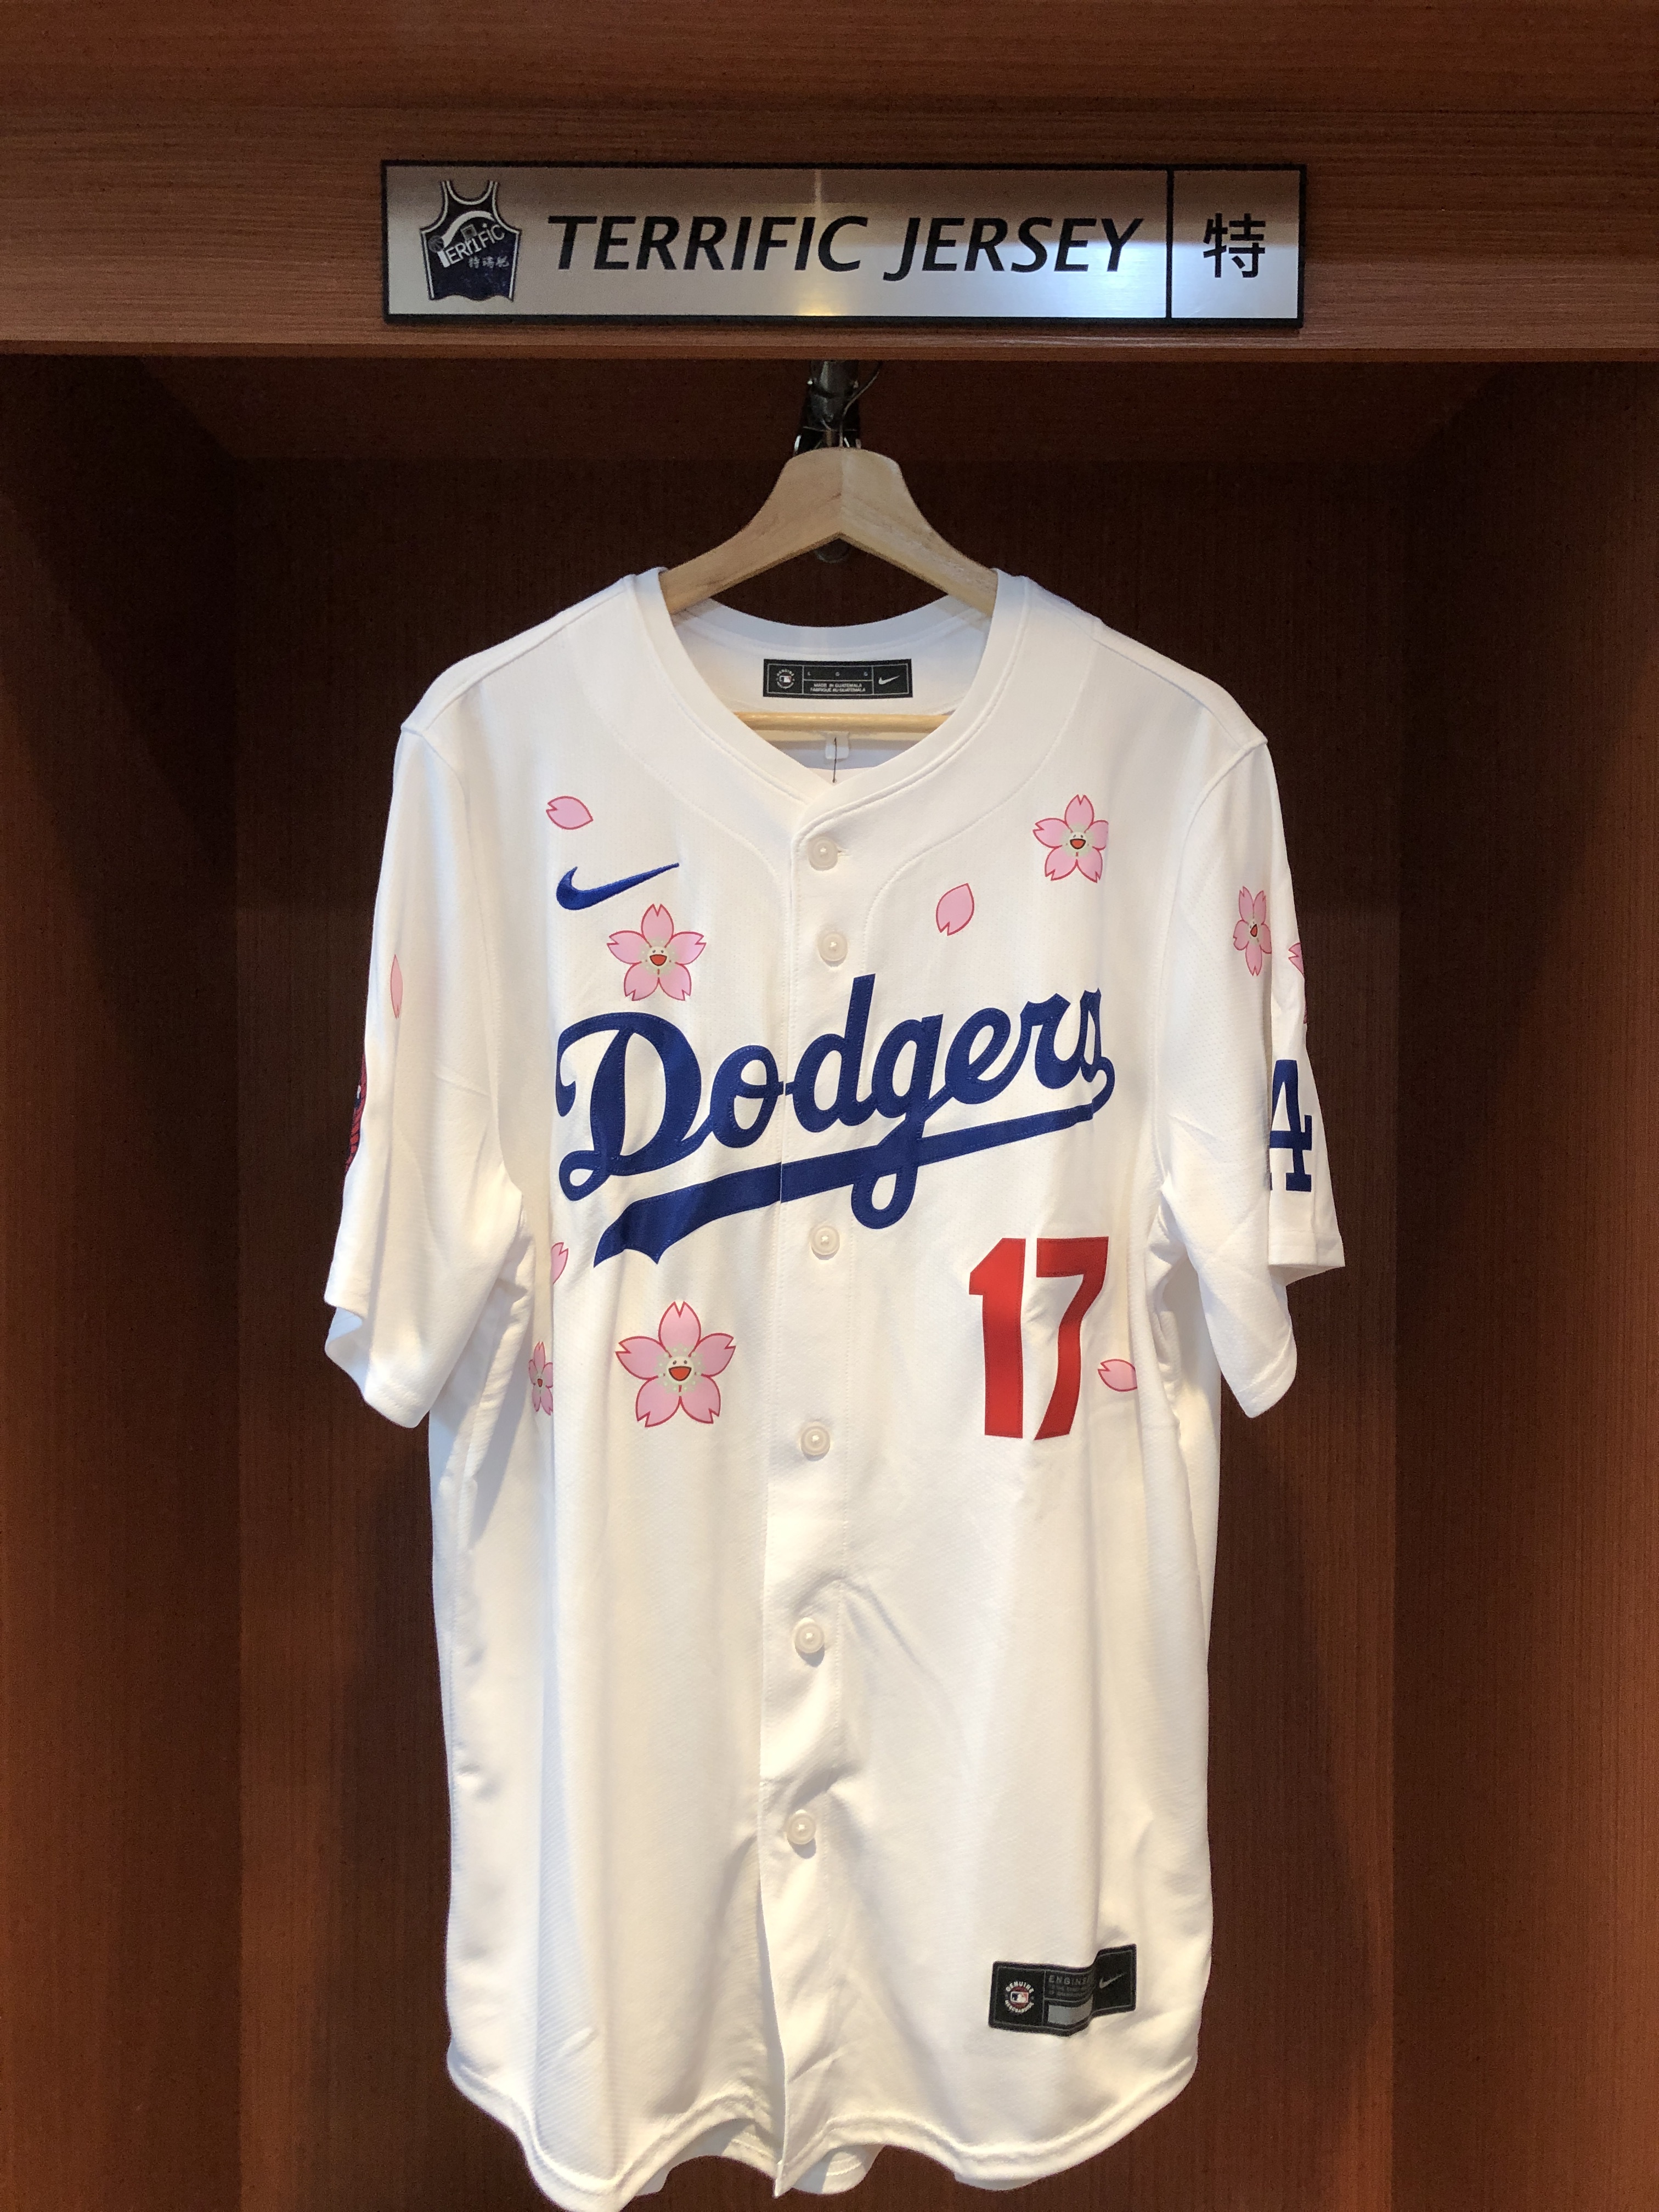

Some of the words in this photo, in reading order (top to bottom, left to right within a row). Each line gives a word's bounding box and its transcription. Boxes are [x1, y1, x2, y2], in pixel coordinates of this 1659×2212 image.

[548, 216, 868, 272] TERRIFIC
[883, 217, 1144, 282] JERSEY
[1203, 213, 1266, 279] 特
[555, 973, 1115, 1230] Dodgers
[968, 1236, 1109, 1441] 17
